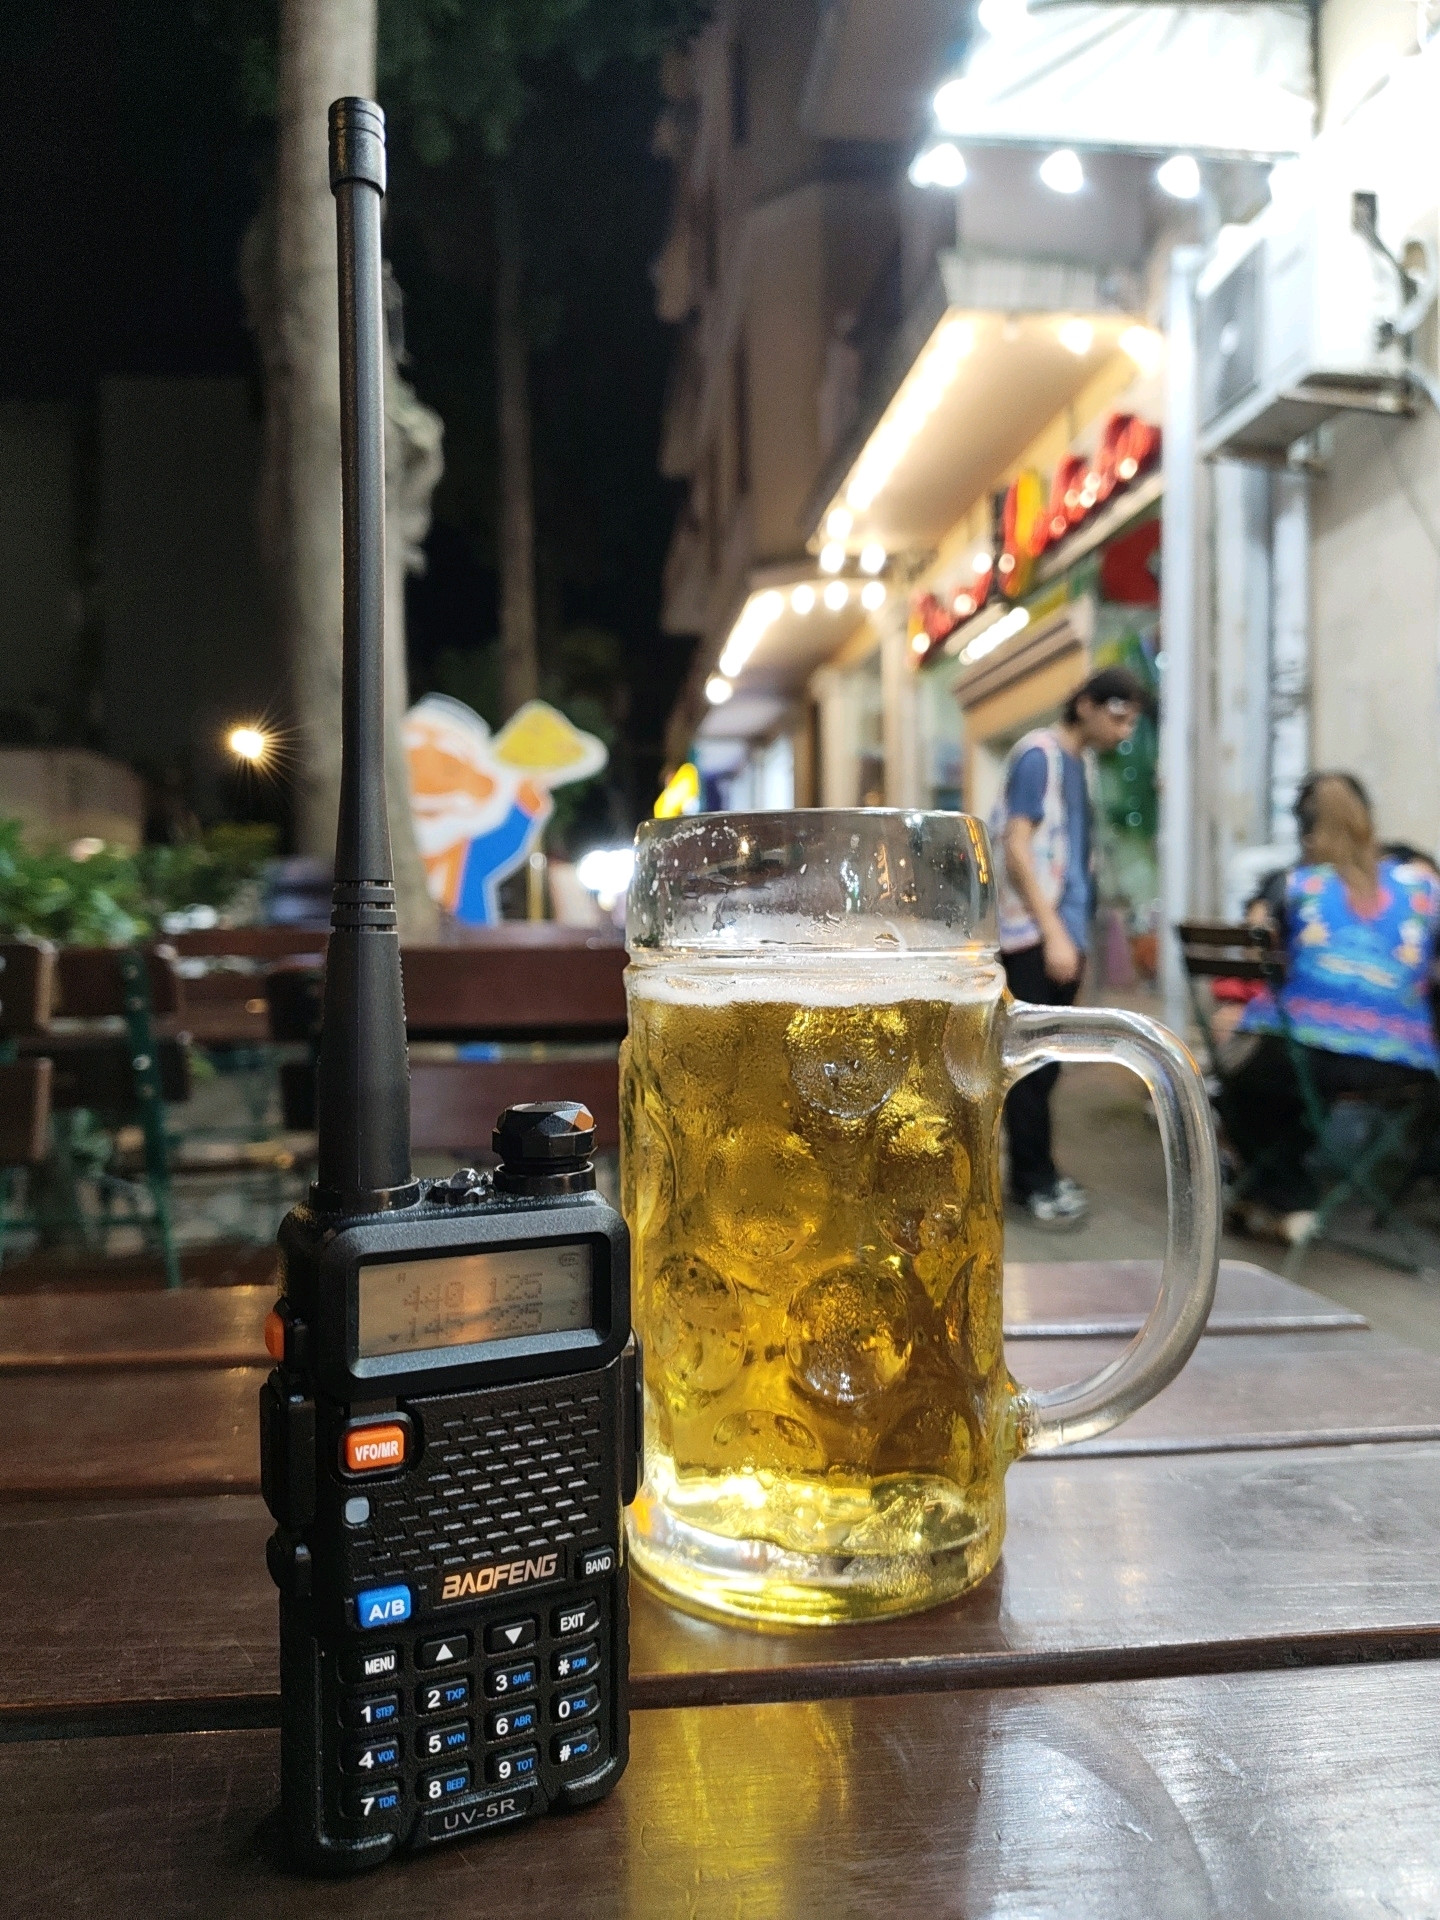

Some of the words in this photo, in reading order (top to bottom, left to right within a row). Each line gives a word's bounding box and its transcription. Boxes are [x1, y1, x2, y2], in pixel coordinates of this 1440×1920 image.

[355, 1440, 399, 1462] VFO/MR
[585, 1557, 611, 1575] BAND
[442, 1554, 558, 1599] BAOFENG
[369, 1600, 405, 1621] A/B
[560, 1612, 585, 1630] EXIT
[365, 1656, 394, 1675] MENU
[496, 1675, 508, 1691] 3
[513, 1672, 531, 1685] SAVE
[428, 1691, 440, 1708] 2
[446, 1688, 465, 1700] TXP
[361, 1706, 371, 1723] 1
[376, 1705, 394, 1718] STEP
[558, 1701, 570, 1717] 0
[496, 1718, 508, 1734] 6
[514, 1714, 531, 1727] ABR
[429, 1735, 441, 1753] 5
[559, 1745, 571, 1761] #
[359, 1752, 374, 1768] 4
[378, 1749, 394, 1761] VOX
[499, 1761, 511, 1778] 9
[517, 1758, 534, 1771] TOT
[429, 1781, 441, 1798] 8
[447, 1777, 465, 1791] BEEP
[360, 1797, 374, 1816] 7
[378, 1796, 396, 1809] TDR
[444, 1798, 516, 1830] UV-5R
